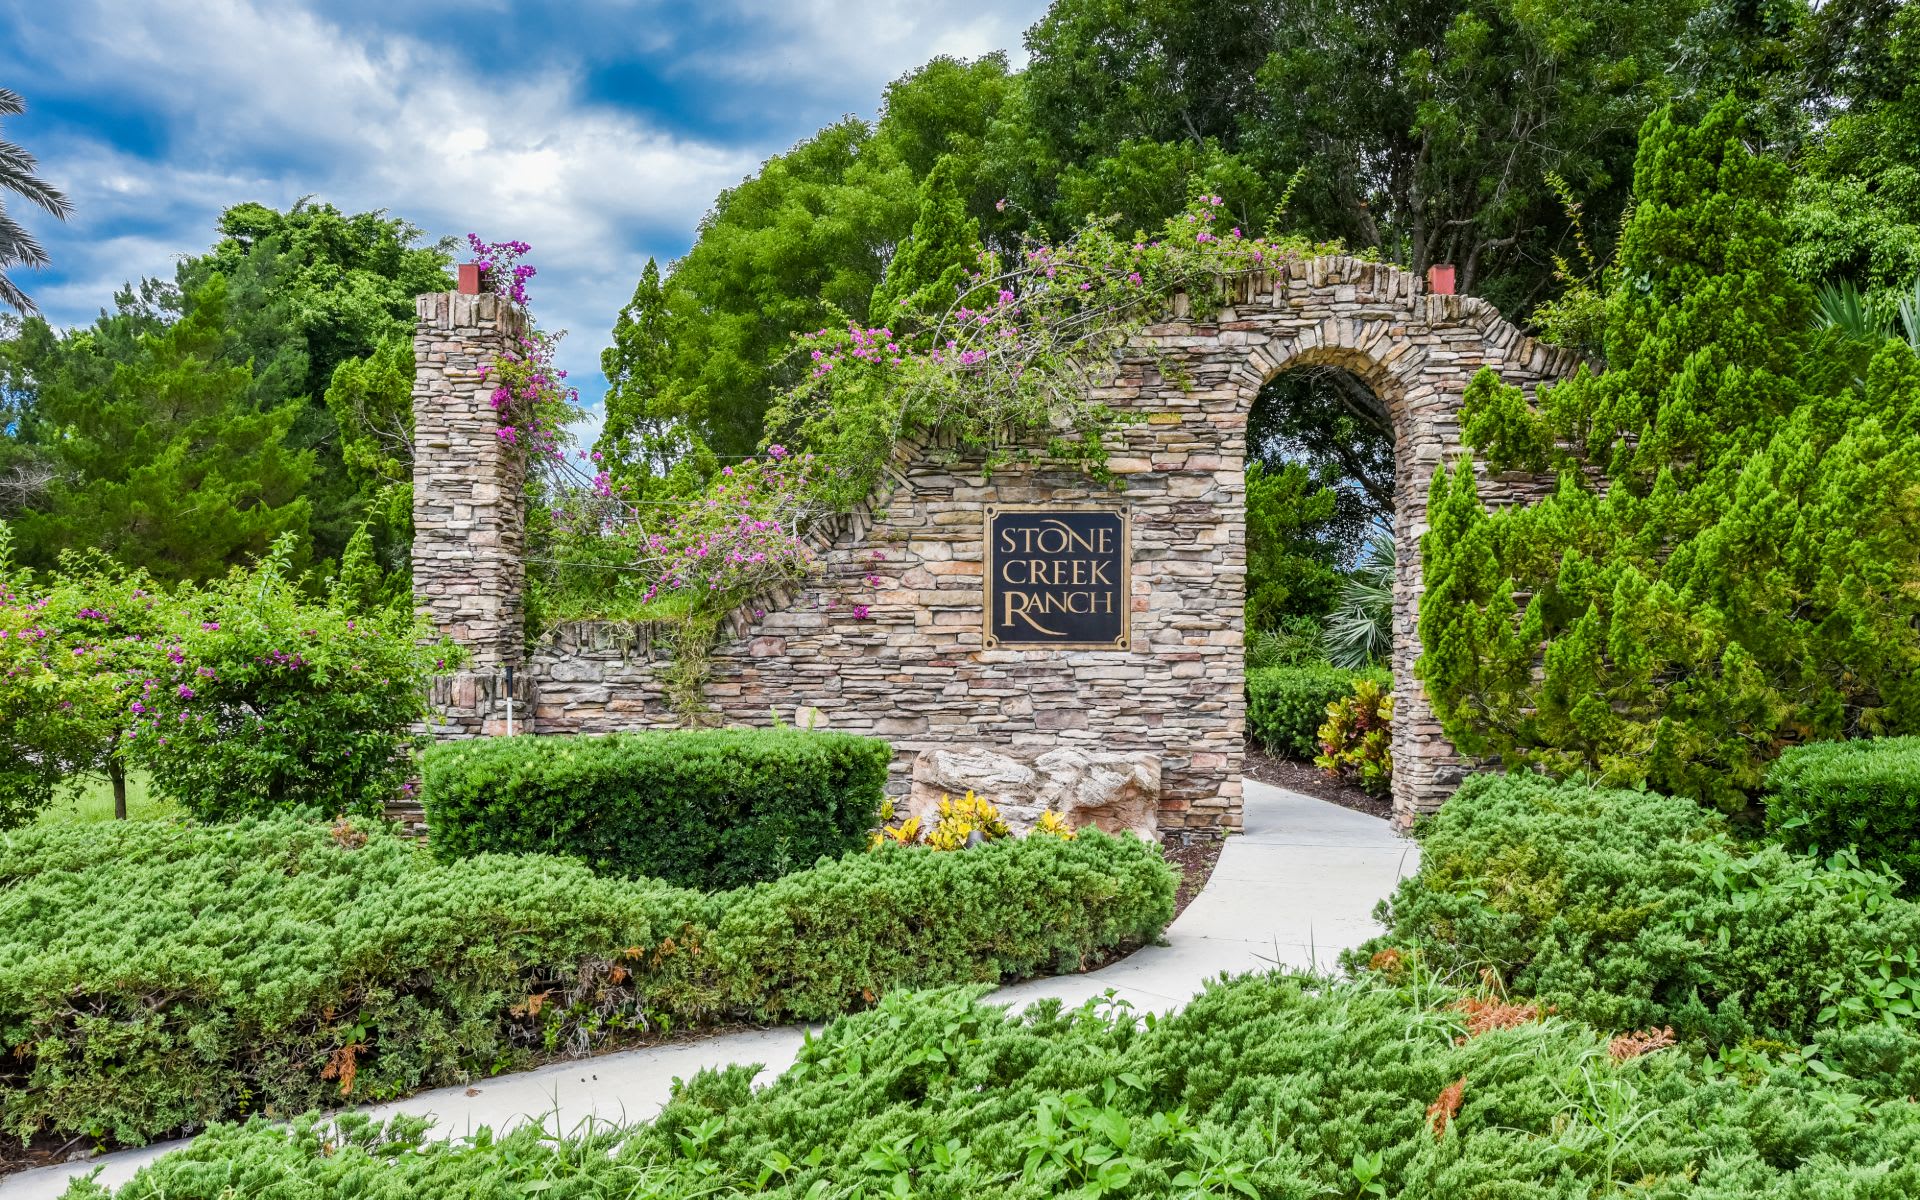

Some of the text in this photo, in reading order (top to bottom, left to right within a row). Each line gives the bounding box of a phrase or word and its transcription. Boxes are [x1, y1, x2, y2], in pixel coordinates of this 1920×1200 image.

[1000, 519, 1114, 553] STONE
[1002, 559, 1113, 585] CREEK
[1001, 591, 1114, 635] RANCH
